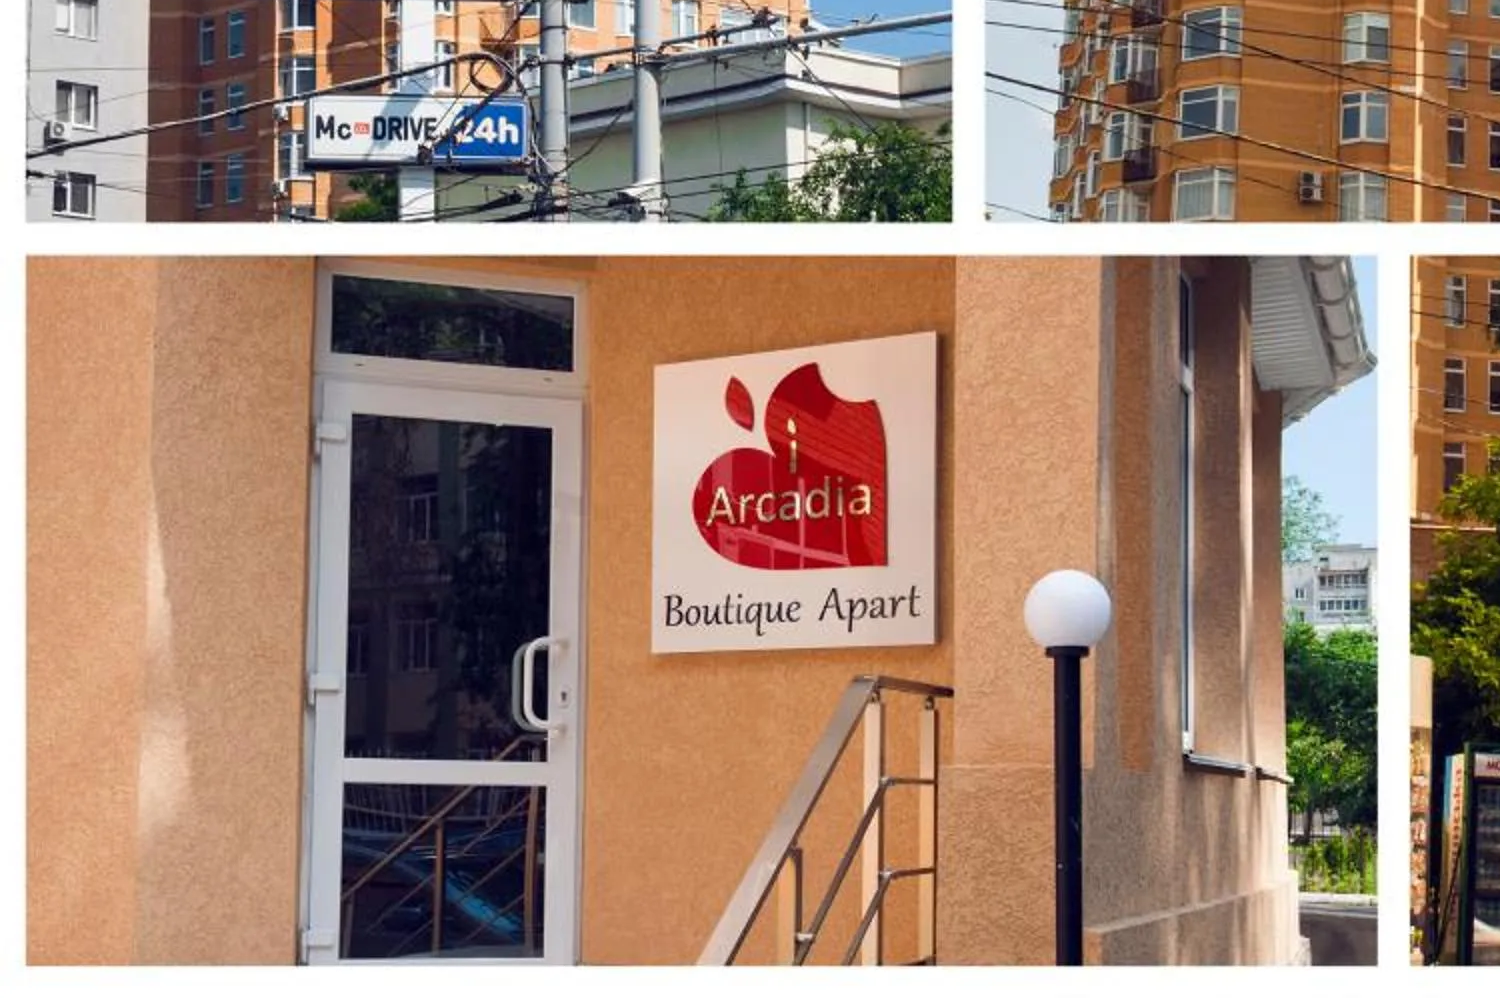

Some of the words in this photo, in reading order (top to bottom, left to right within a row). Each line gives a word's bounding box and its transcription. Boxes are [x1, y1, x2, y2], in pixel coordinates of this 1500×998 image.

[315, 114, 352, 141] Mc
[373, 115, 437, 142] DRIVE
[453, 116, 519, 145] 24h
[786, 418, 798, 475] i
[706, 475, 872, 527] Arcadia
[663, 593, 802, 637] Boutique
[818, 585, 922, 633] Apart
